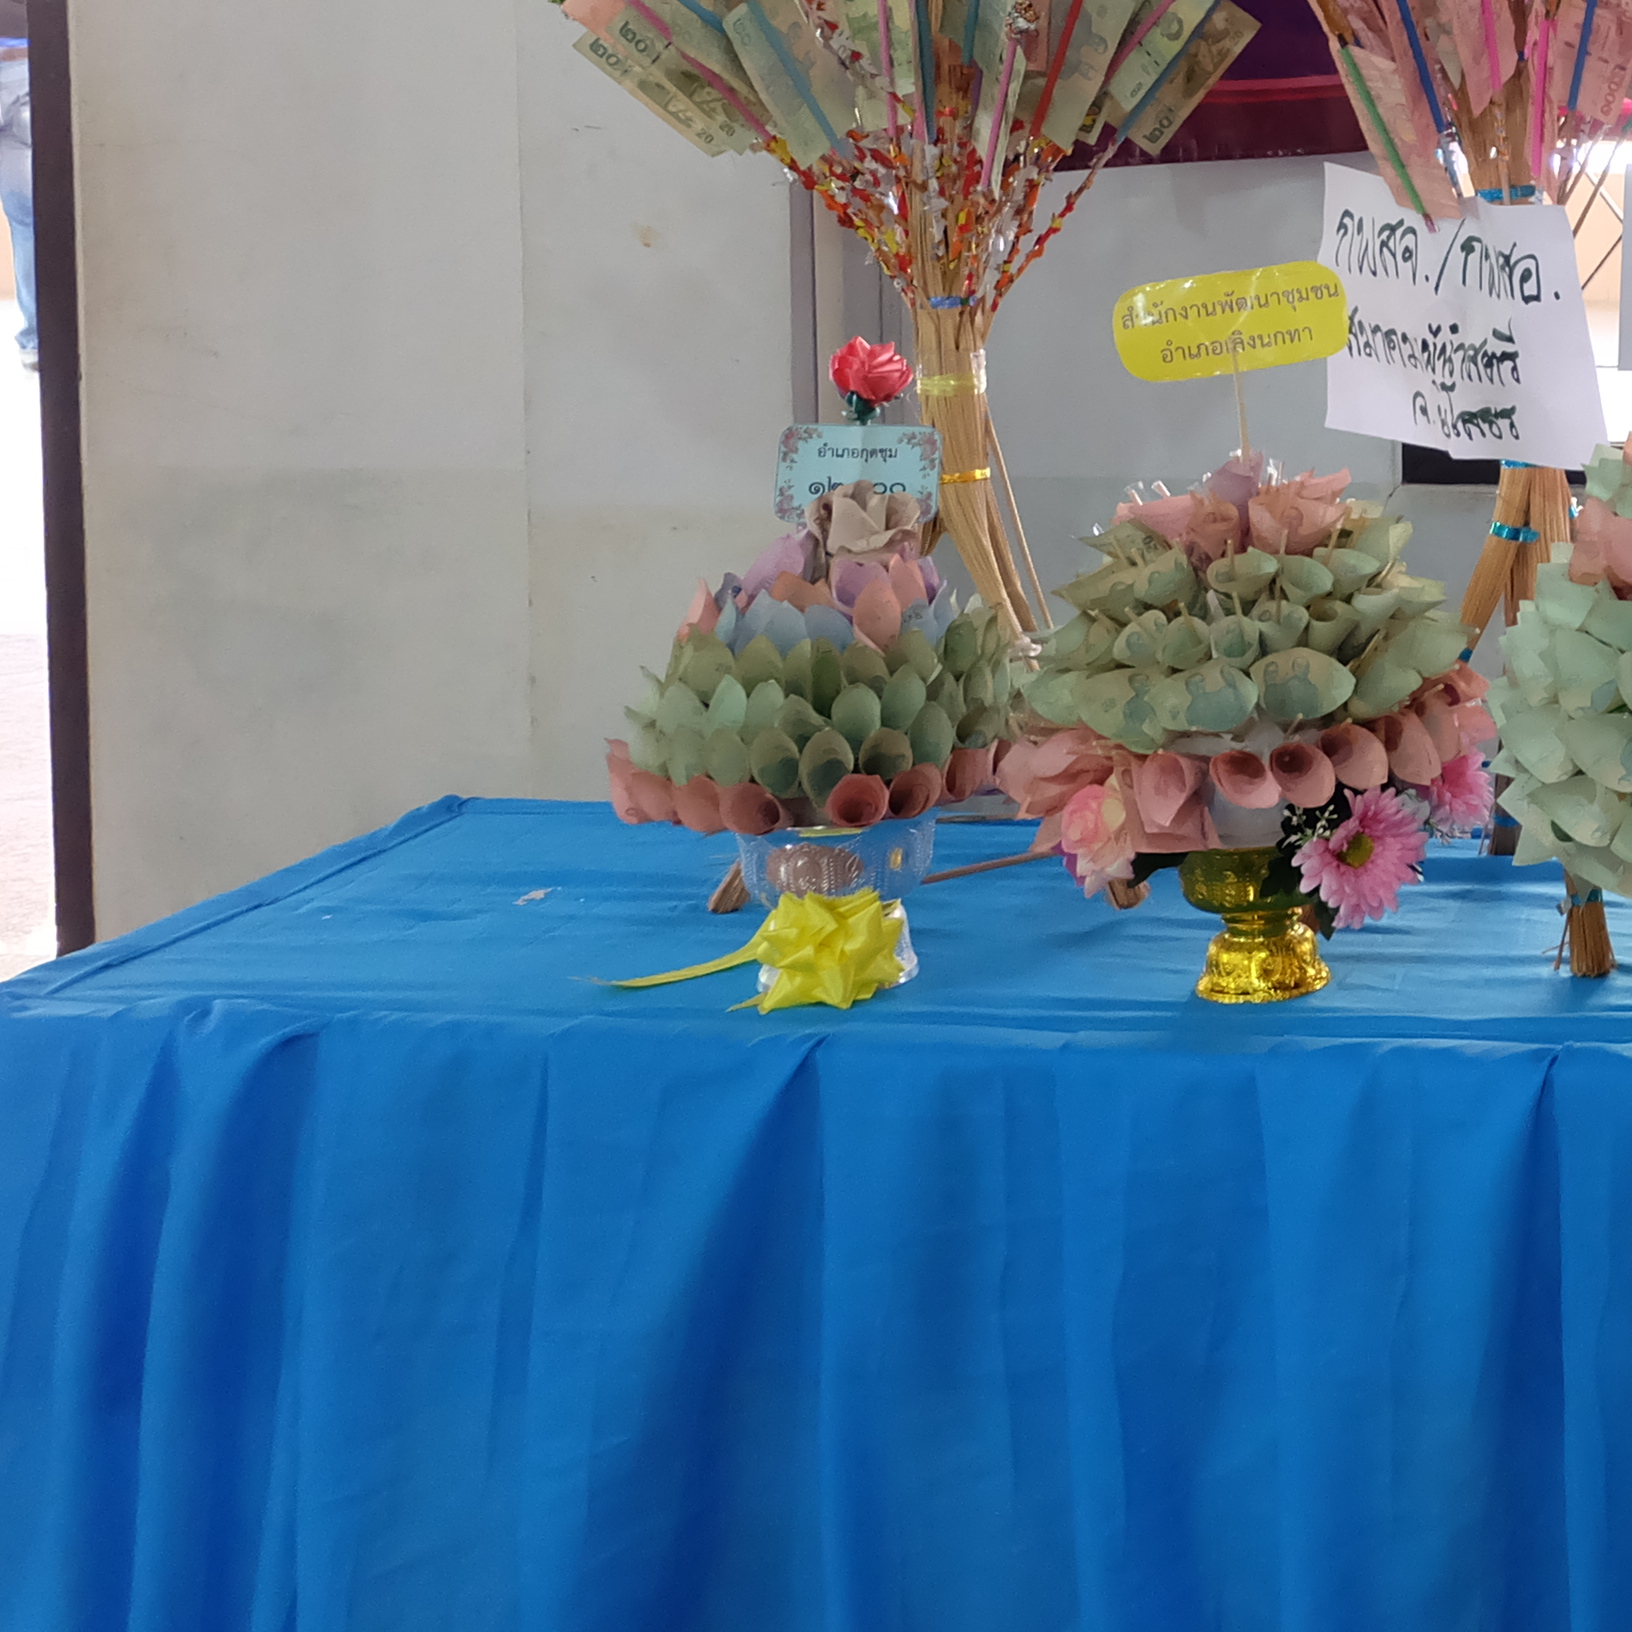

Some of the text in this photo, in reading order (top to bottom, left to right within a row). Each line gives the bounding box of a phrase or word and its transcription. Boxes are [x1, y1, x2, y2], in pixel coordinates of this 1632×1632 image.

[1120, 277, 1341, 331] สำนักงานพัฒนาชุมชน
[1160, 322, 1315, 366] อำเภอเลิงนกทา
[817, 442, 899, 463] อำเภอกุดชุม
